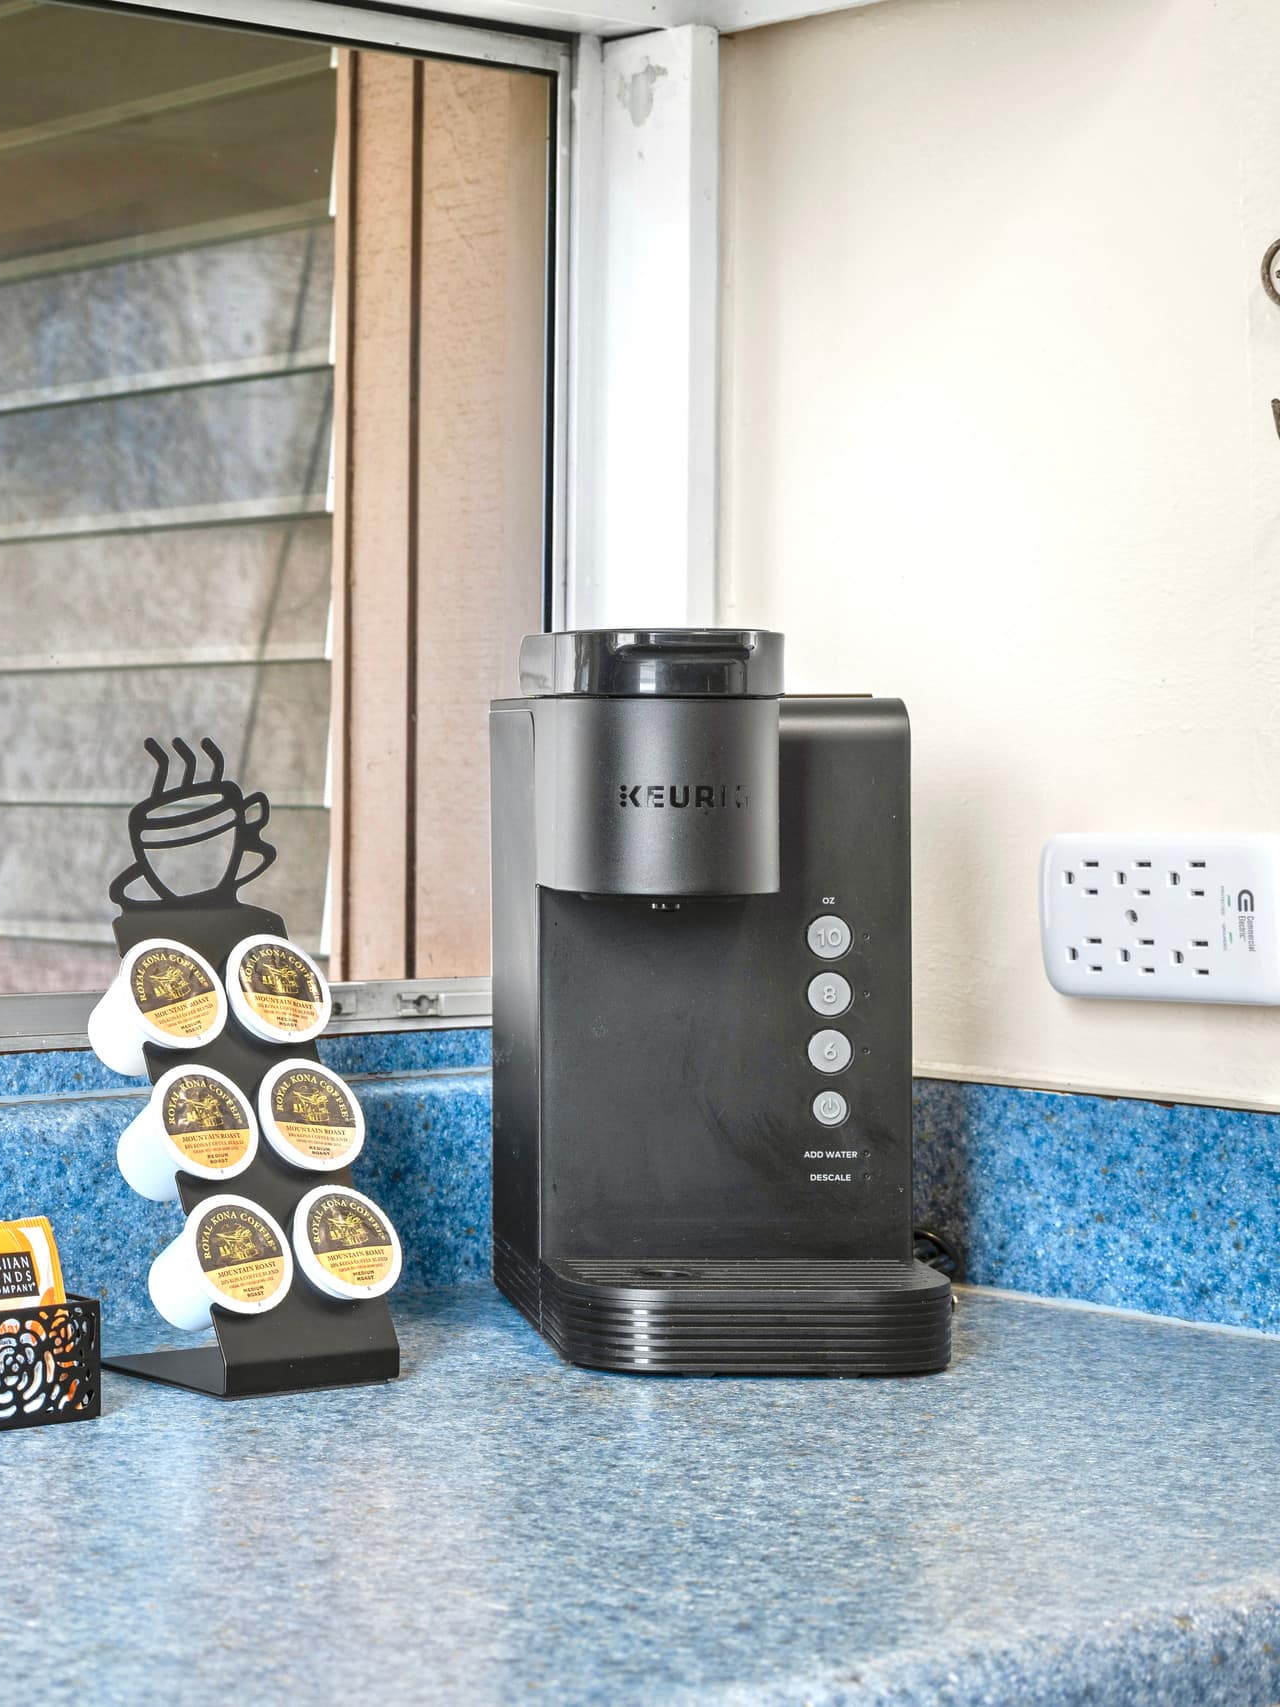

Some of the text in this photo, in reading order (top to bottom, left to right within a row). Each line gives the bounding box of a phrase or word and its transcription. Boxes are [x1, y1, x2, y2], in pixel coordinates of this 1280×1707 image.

[822, 897, 835, 905] OZ
[817, 928, 842, 947] 10
[259, 949, 286, 959] KONA
[136, 953, 207, 1002] ROYAL KONA COFFEE
[254, 995, 291, 1005] MOUNTAIN
[823, 984, 837, 1003] 8
[824, 1043, 837, 1060] 6
[168, 1080, 240, 1125] ROYAL KONA COFFEE
[277, 1074, 349, 1118] ROYAL KONA COFFEE
[182, 1133, 219, 1142] MOUNTAIN
[286, 1125, 345, 1136] MOUNTAIN ROAST
[804, 1151, 858, 1159] ADD WATER
[810, 1174, 852, 1182] DESCALE
[312, 1199, 384, 1243] ROYAL KONA COFFEE
[203, 1211, 275, 1260] ROYAL KONA COFFEE
[327, 1248, 384, 1261] MOUNTAIN ROAST
[217, 1260, 276, 1277] MOUNTAIN ROAST
